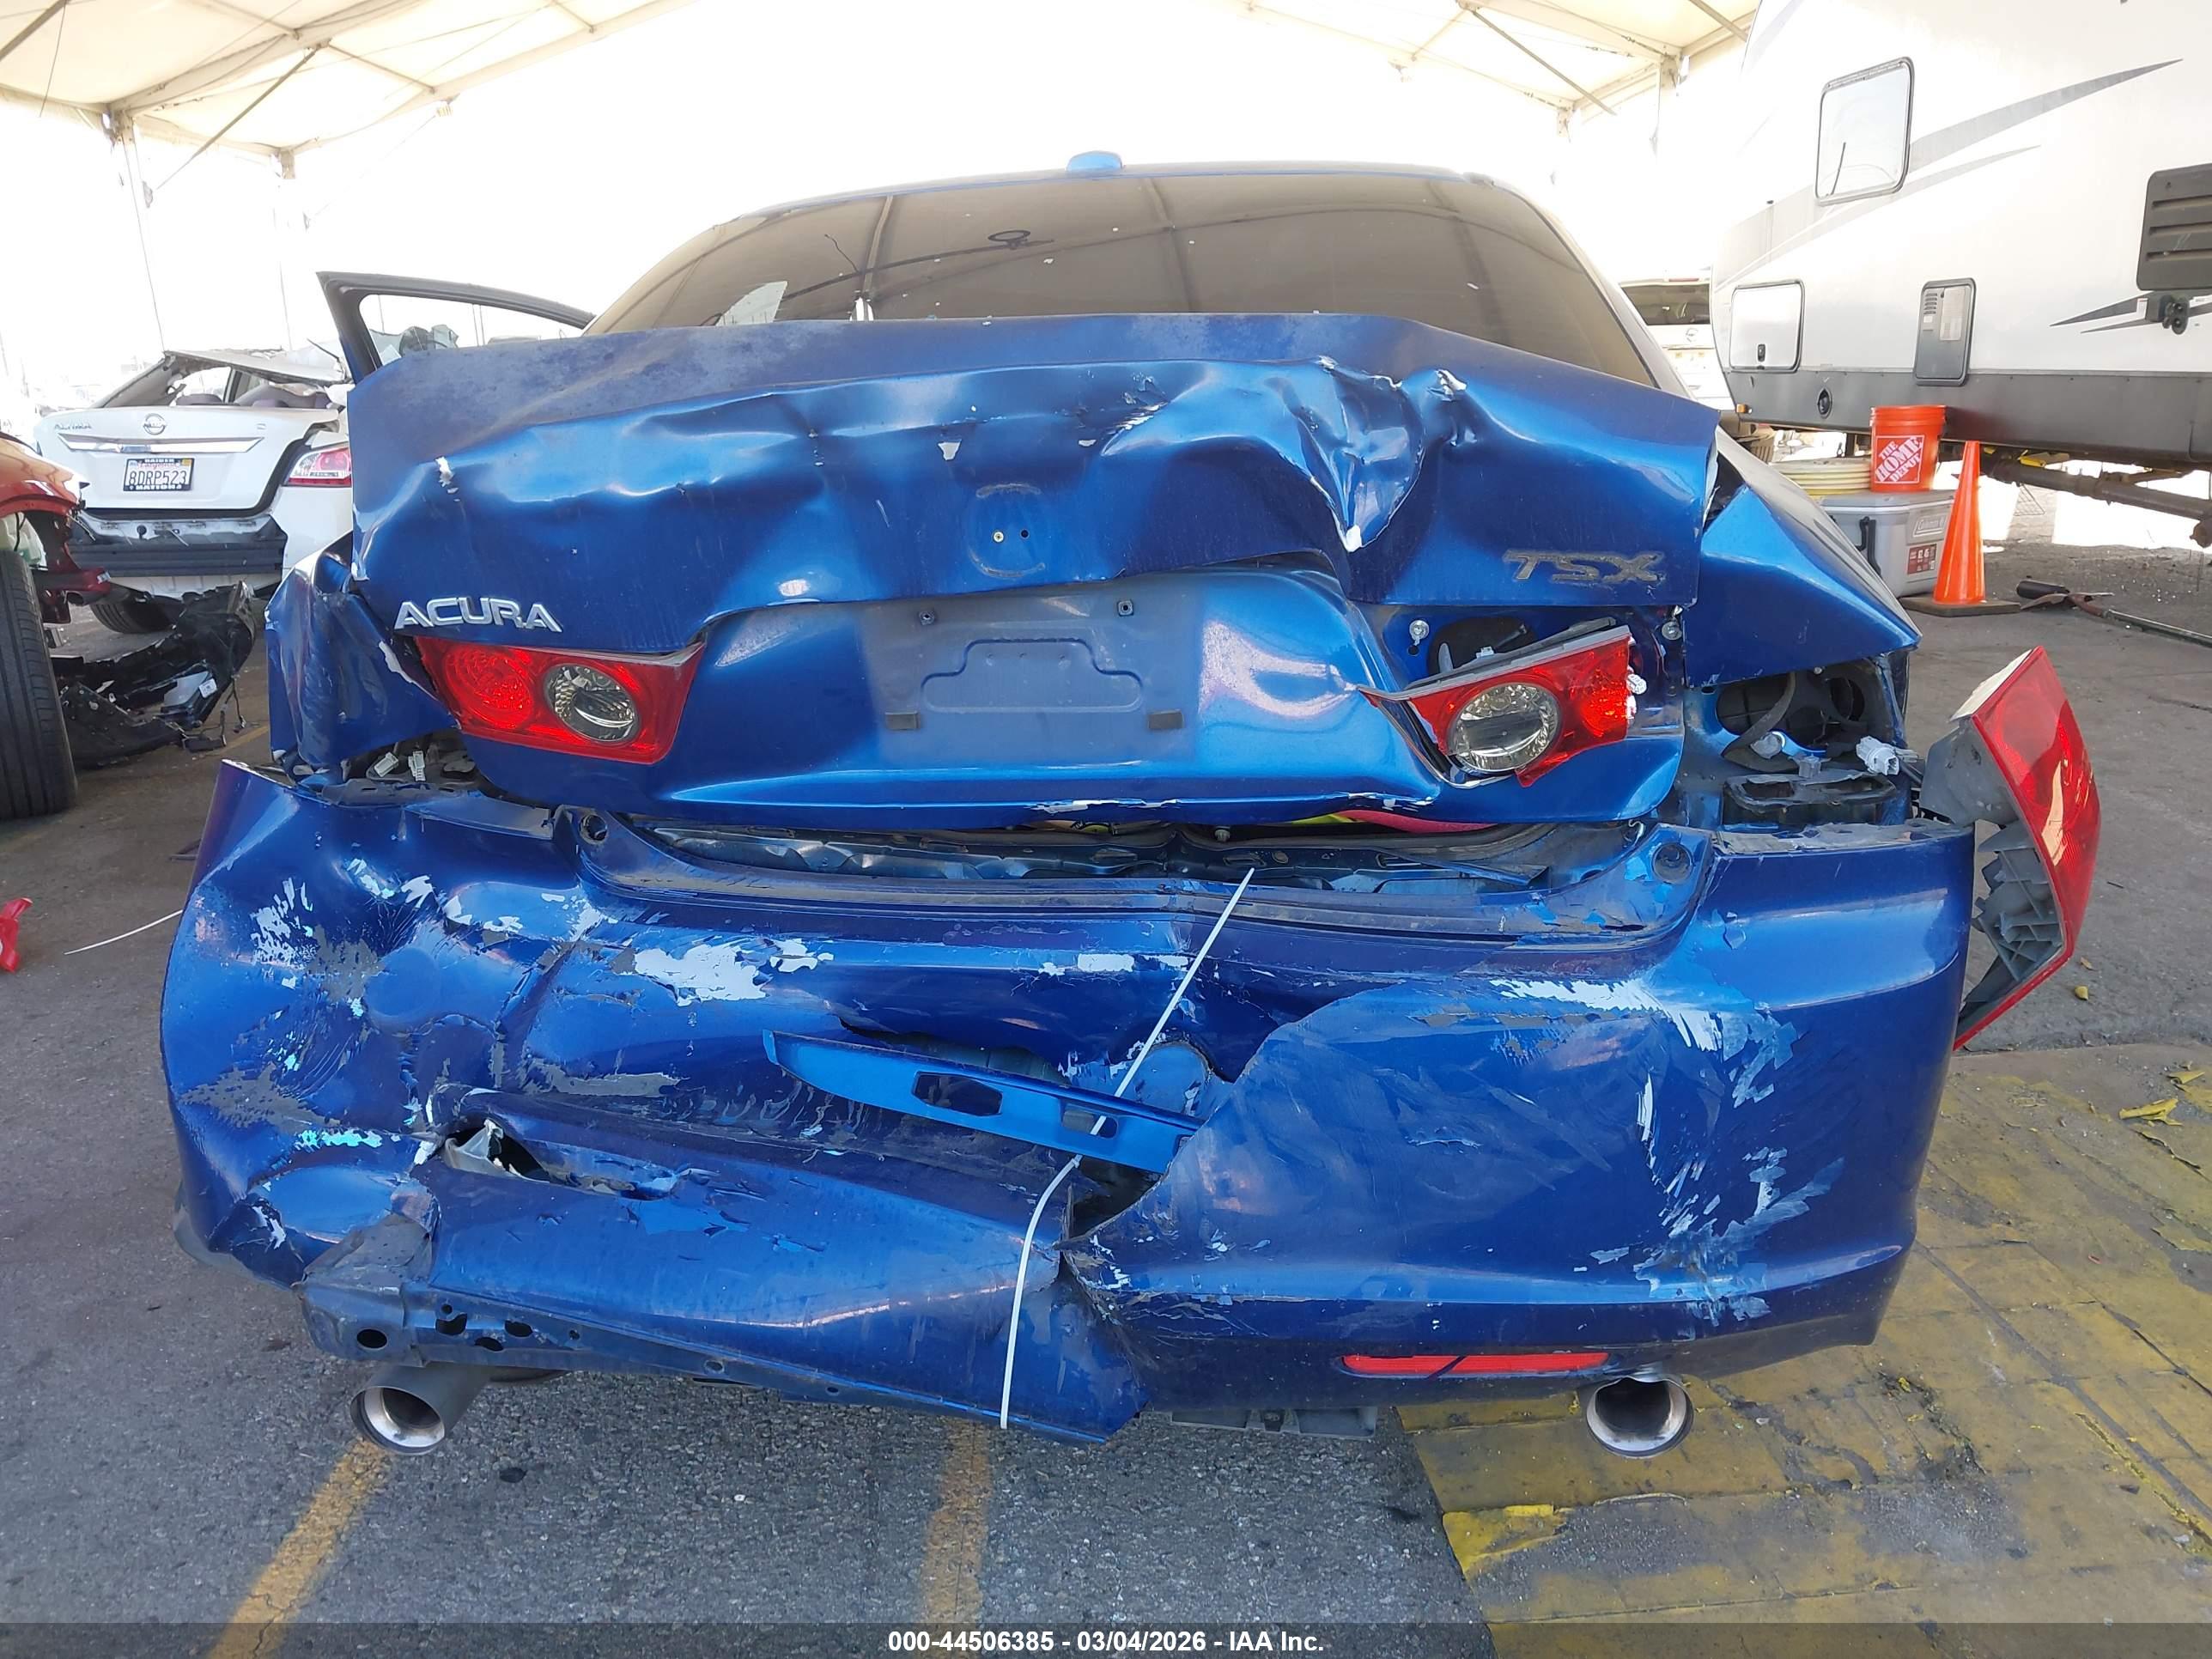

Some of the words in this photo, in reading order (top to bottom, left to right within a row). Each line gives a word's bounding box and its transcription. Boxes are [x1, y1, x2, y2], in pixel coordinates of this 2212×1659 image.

[1875, 436, 1923, 482] HOME
[1879, 441, 1899, 460] THE
[129, 470, 187, 486] 8DRP523
[1889, 453, 1920, 482] DEPOT
[1502, 550, 1664, 584] TSX
[393, 597, 563, 633] ACURA
